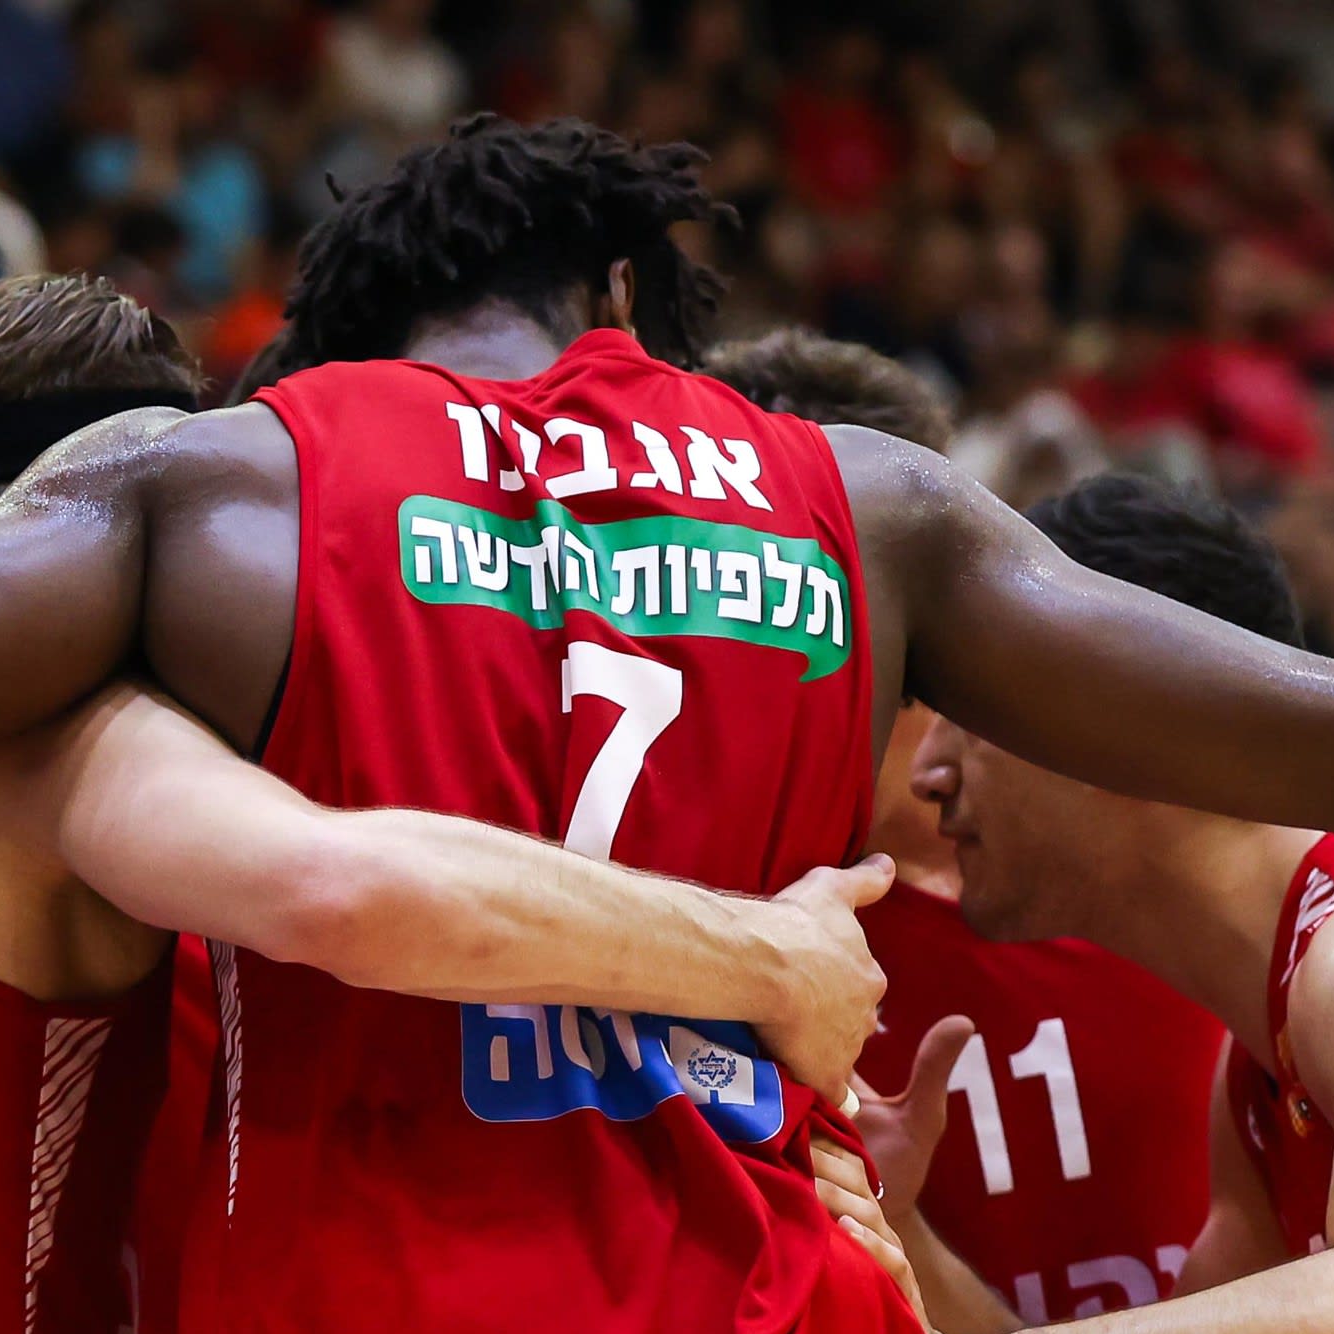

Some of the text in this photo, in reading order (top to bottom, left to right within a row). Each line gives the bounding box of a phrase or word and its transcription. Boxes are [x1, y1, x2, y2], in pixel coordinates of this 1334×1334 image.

[610, 541, 846, 647] תלפיות
[561, 640, 683, 861] 7
[946, 1018, 1091, 1195] 11
